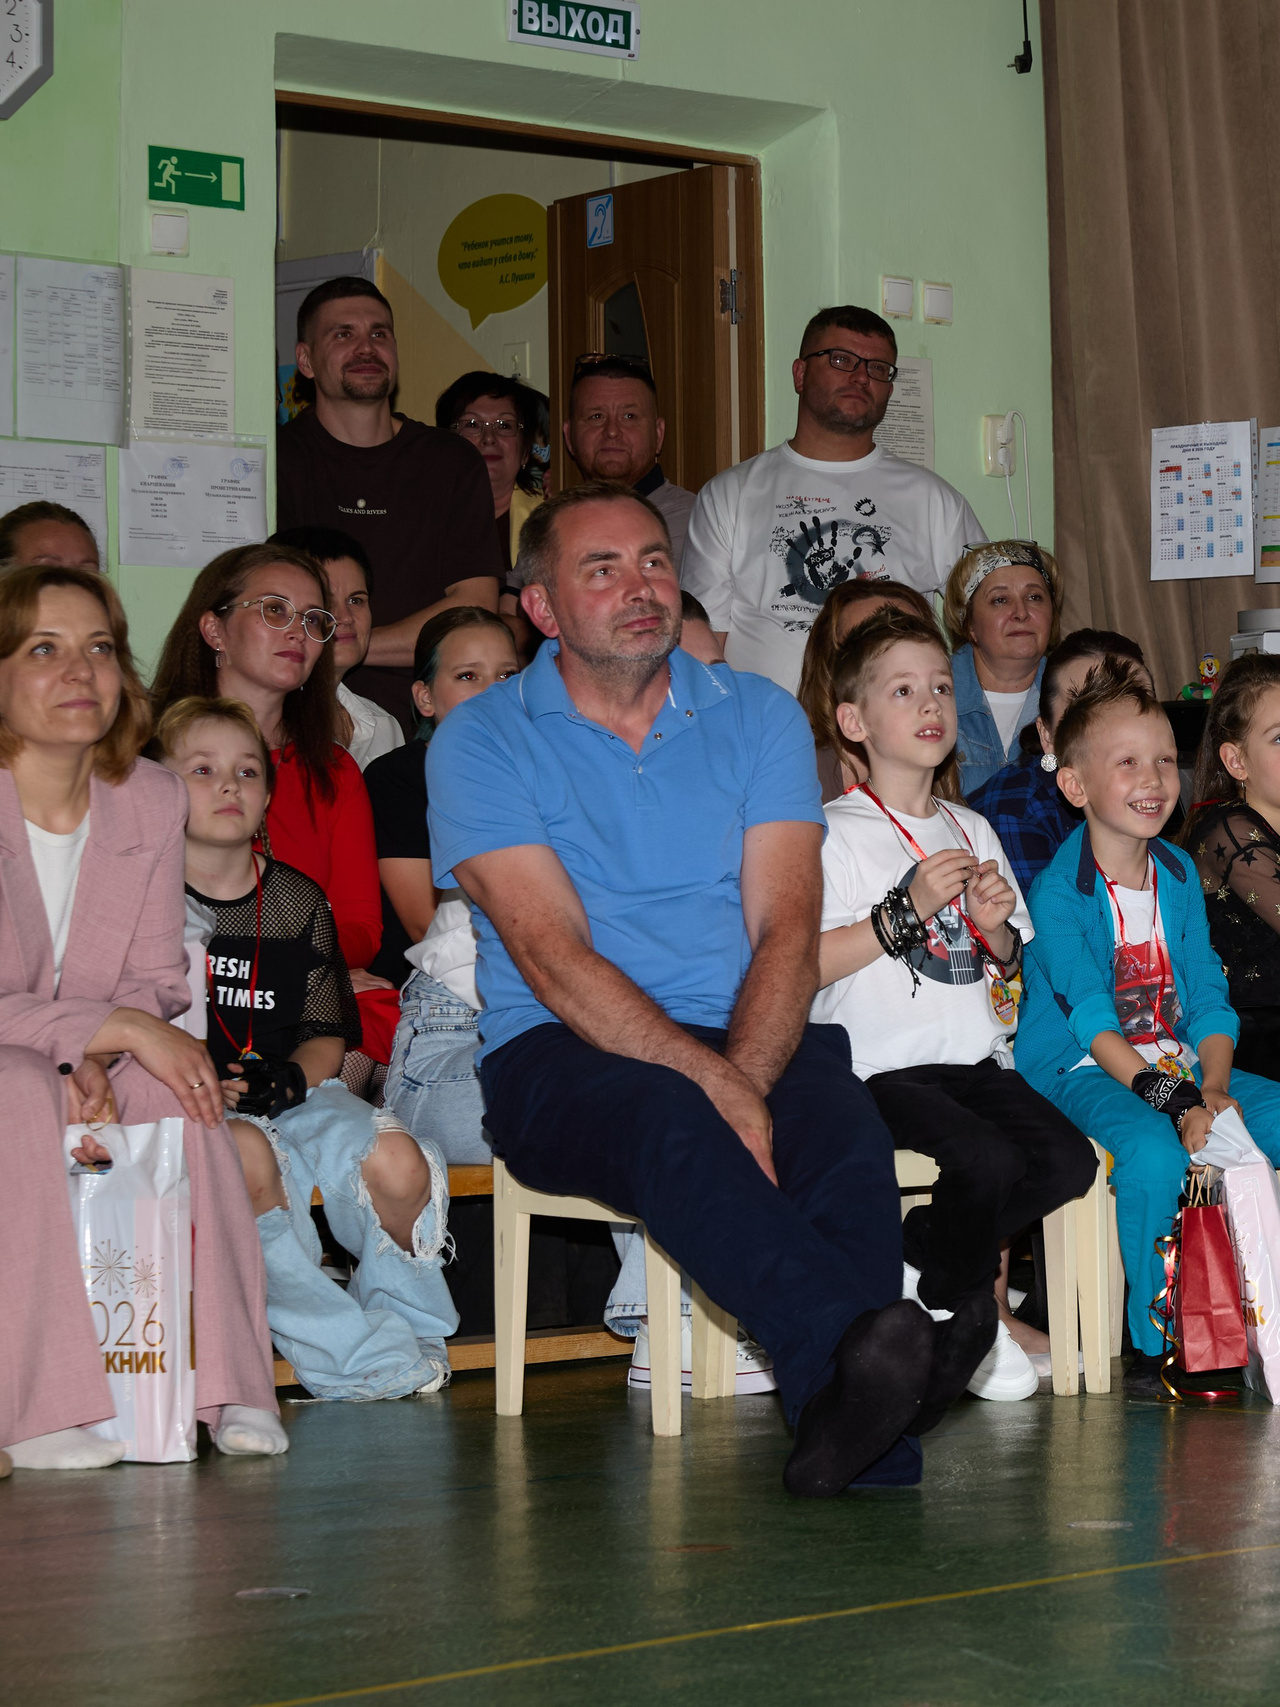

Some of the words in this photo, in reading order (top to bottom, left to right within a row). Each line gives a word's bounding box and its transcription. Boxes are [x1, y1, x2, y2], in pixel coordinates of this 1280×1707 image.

[5, 0, 17, 16] 2
[9, 23, 23, 43] 3
[521, 0, 626, 46] ВЫХОД
[5, 50, 16, 68] 4
[511, 272, 536, 285] Пушкин
[207, 954, 251, 980] RESH
[216, 985, 275, 1010] TIMES
[90, 1300, 165, 1347] 026
[102, 1350, 168, 1374] КНИК
